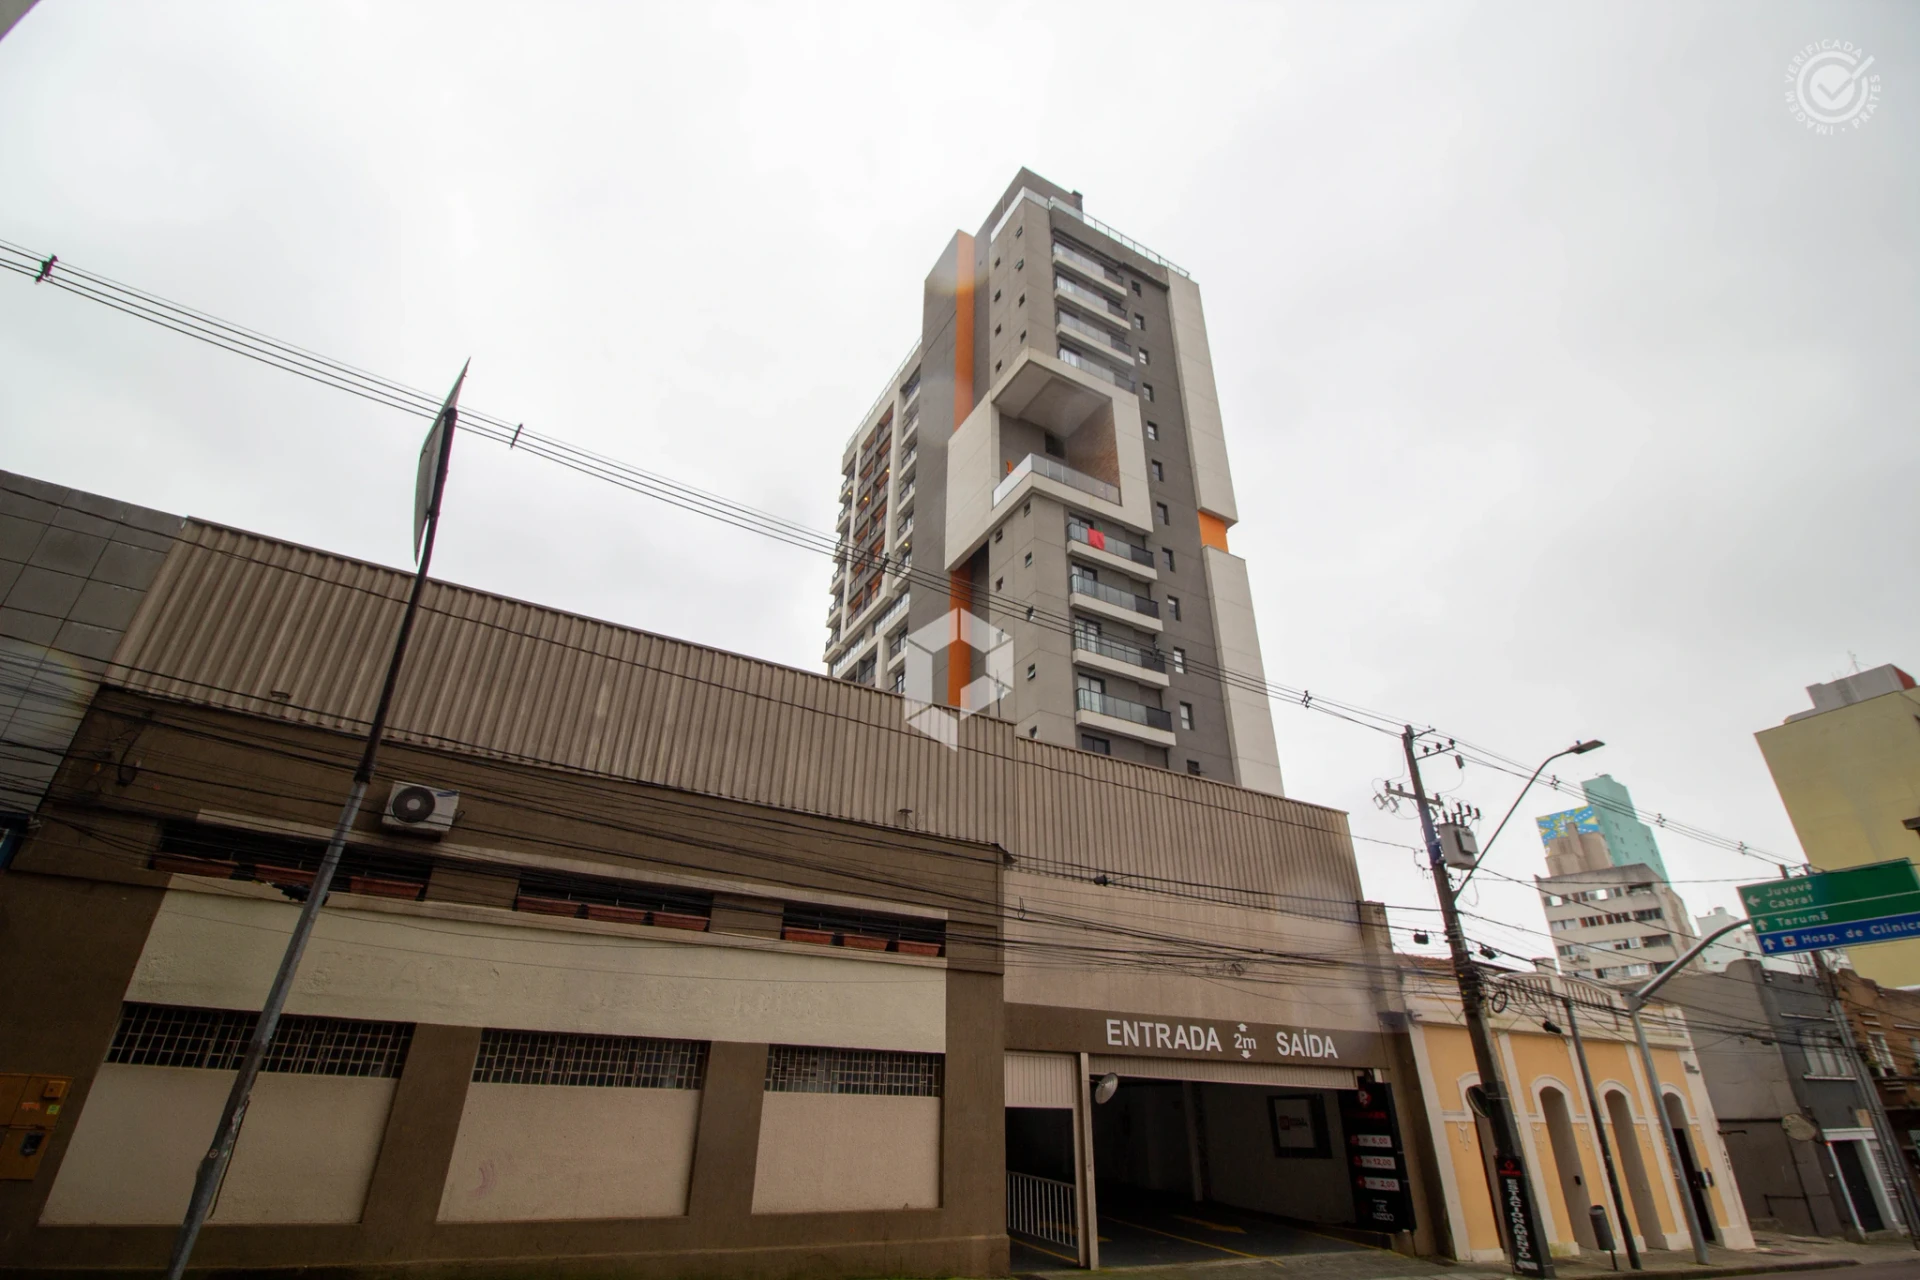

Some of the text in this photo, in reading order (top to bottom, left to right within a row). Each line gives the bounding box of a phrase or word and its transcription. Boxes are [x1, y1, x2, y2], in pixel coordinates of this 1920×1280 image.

[1765, 881, 1813, 897] Juvevê
[1769, 894, 1814, 908] Cabral
[1775, 911, 1829, 927] Tarumã
[1801, 932, 1840, 945] Hosp.
[1845, 929, 1864, 938] de
[1105, 1018, 1339, 1060] ENTRADA 2m SAÍDA
[1505, 1178, 1531, 1259] ESTACIONAMENTO
